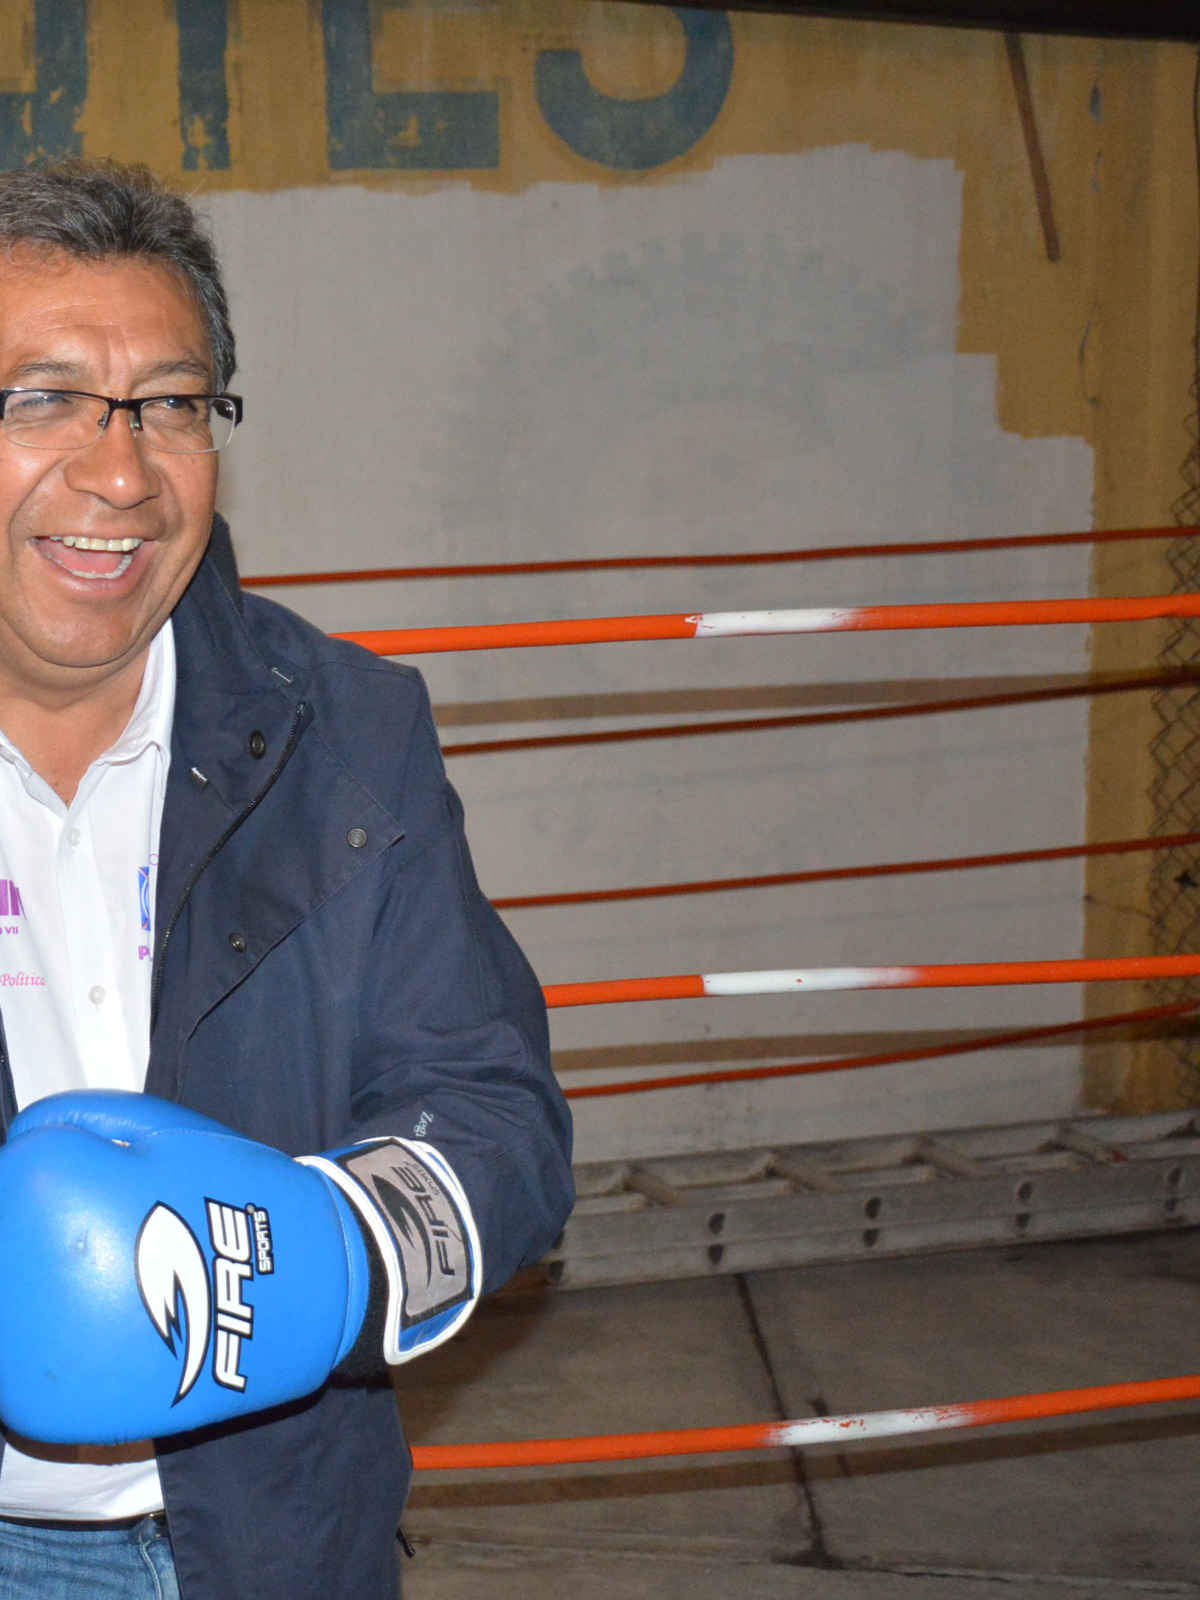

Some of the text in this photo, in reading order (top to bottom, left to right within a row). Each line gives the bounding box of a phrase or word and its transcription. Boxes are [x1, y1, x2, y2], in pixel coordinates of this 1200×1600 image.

[253, 1209, 273, 1273] SPORTS
[389, 1165, 456, 1277] FIRE
[205, 1198, 254, 1393] FIRE
